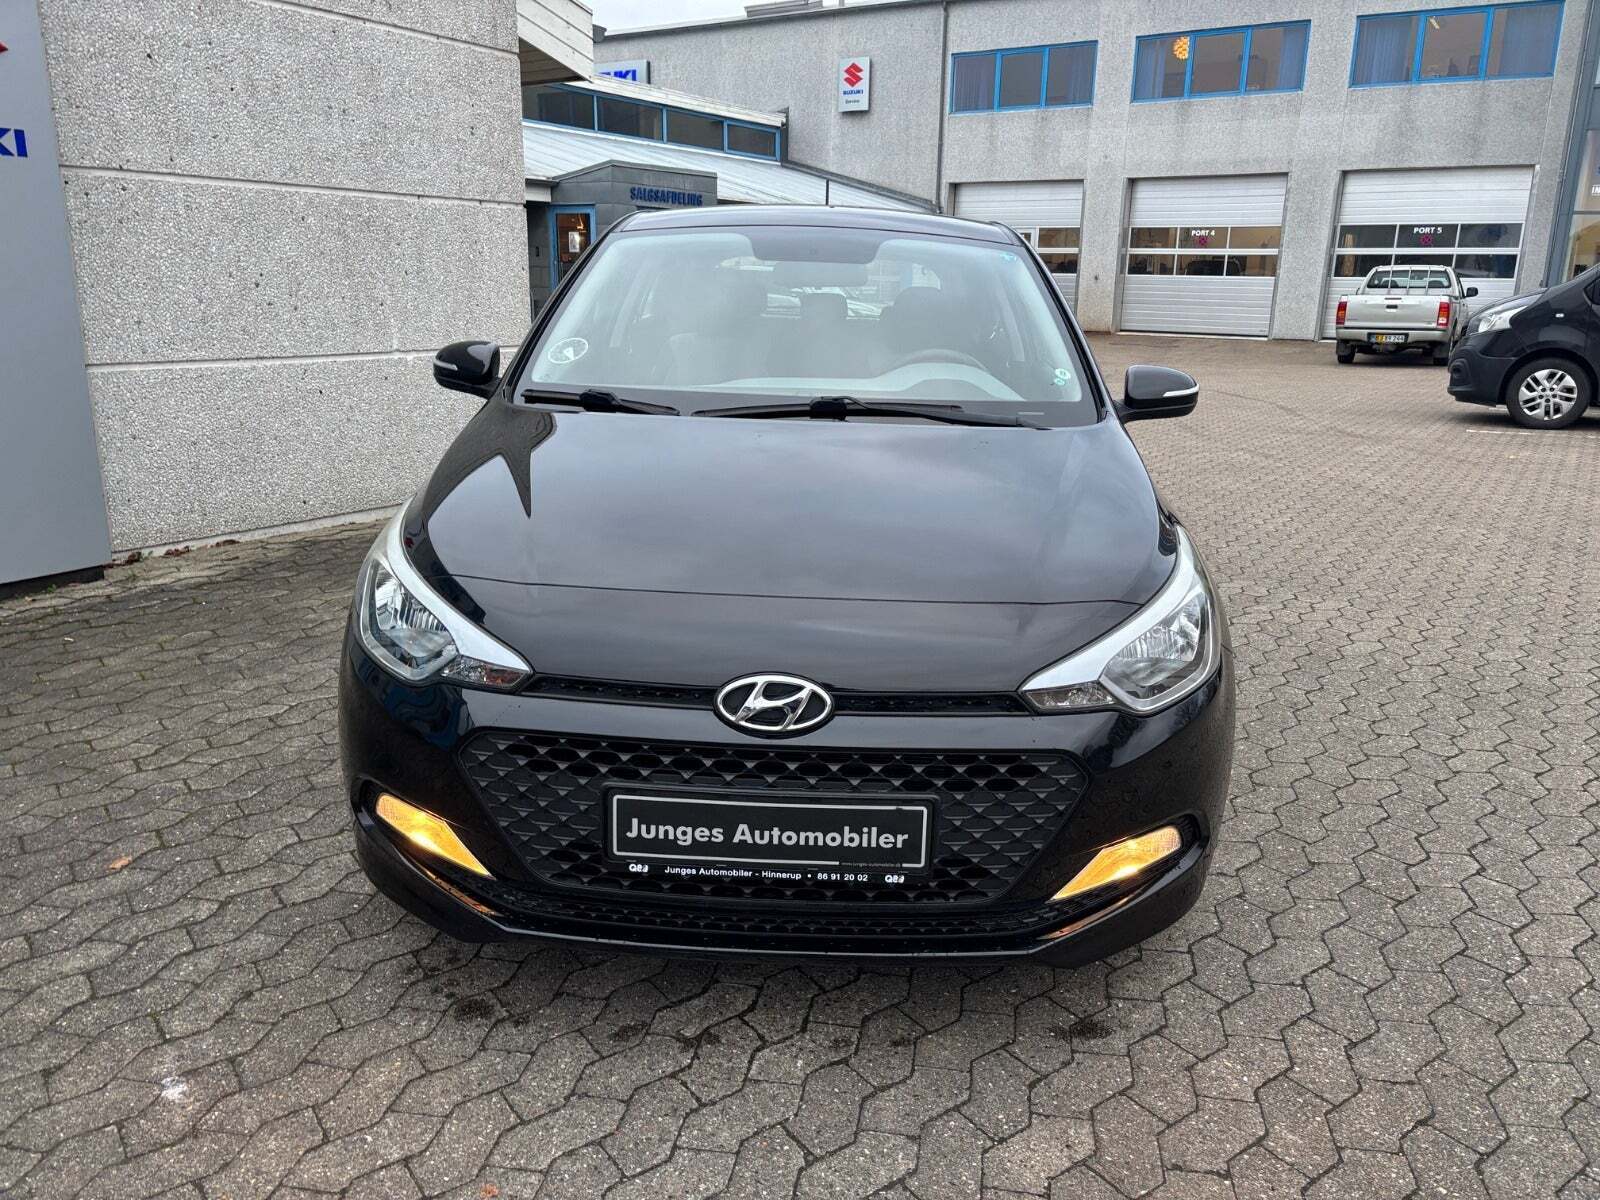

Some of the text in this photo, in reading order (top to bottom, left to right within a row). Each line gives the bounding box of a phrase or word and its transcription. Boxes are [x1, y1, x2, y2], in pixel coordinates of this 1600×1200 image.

[1413, 226, 1435, 234] PORT
[626, 818, 909, 849] Junges Automobiler
[664, 866, 697, 876] Junges
[699, 867, 753, 877] Automobiler
[761, 870, 802, 881] Hinnerup
[817, 872, 829, 881] 86
[830, 873, 841, 881] 91
[843, 873, 855, 881] 20
[857, 874, 869, 882] 02
